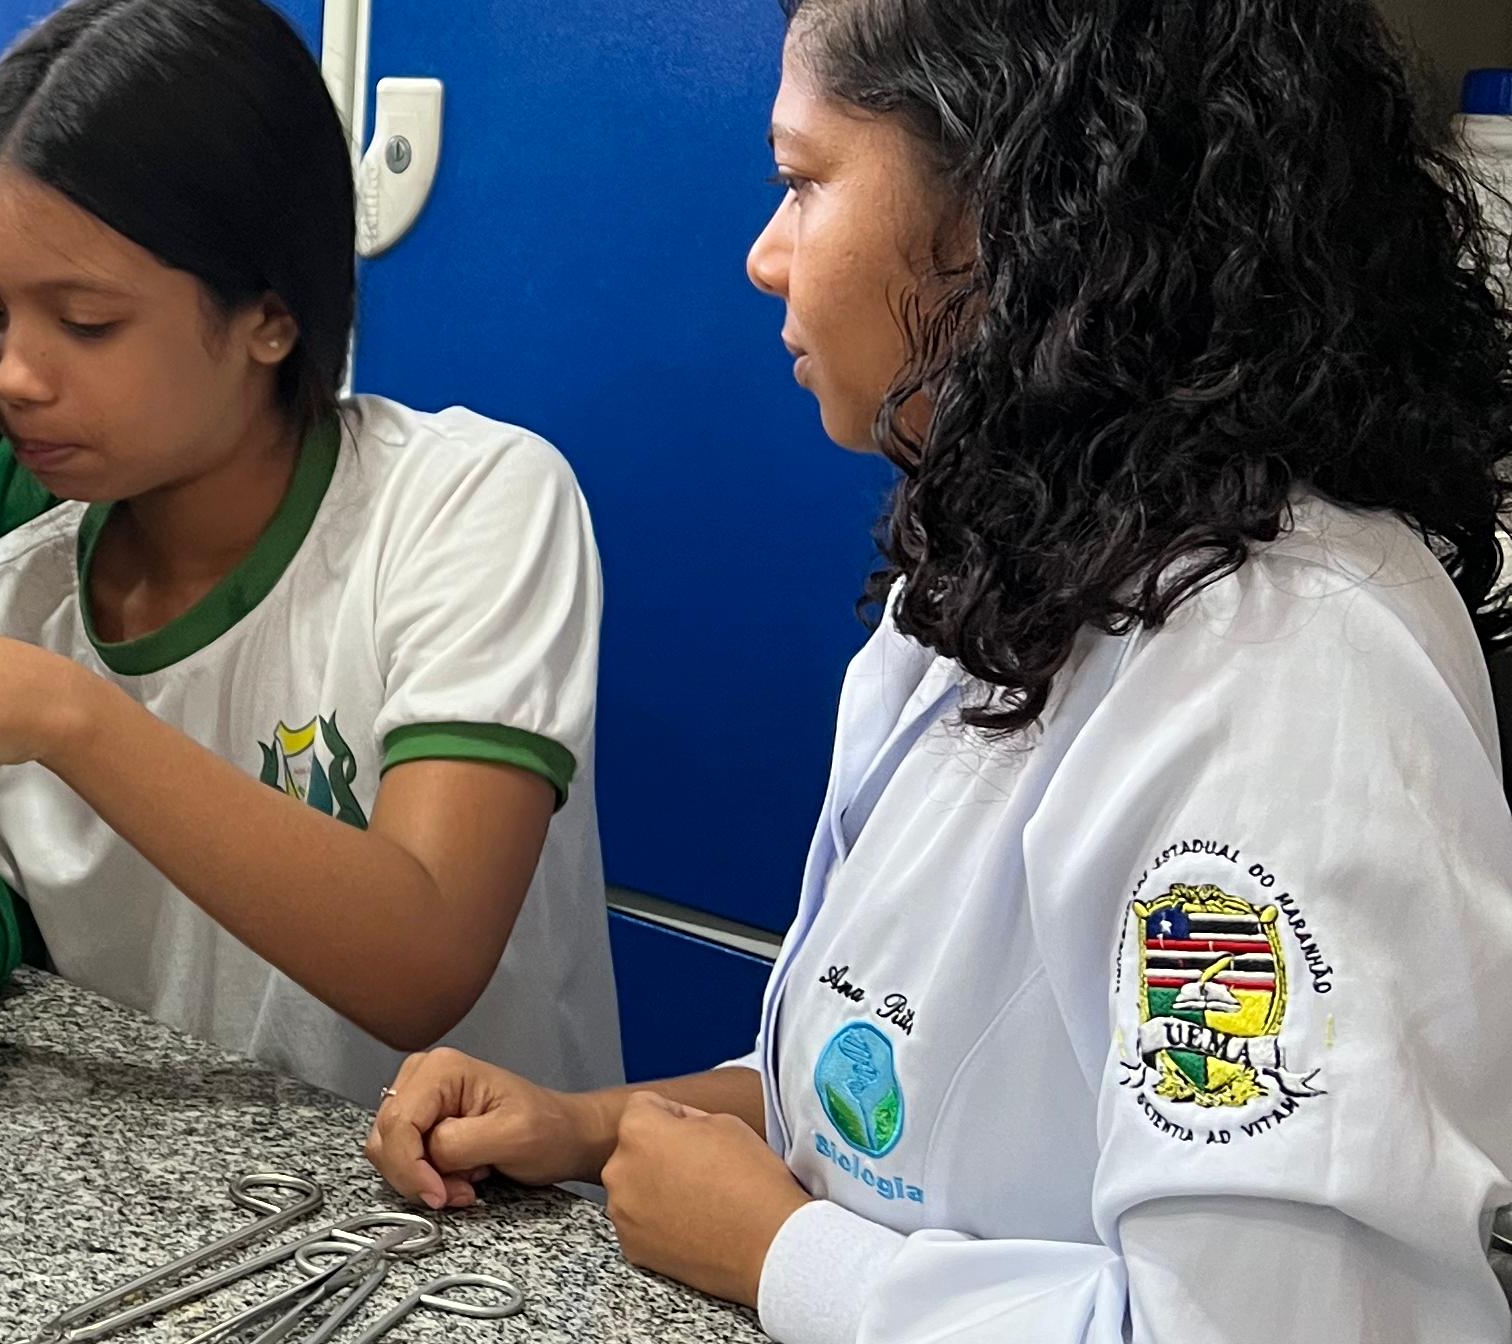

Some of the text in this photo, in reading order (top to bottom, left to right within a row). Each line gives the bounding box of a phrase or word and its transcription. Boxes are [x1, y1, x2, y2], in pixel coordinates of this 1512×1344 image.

[1248, 863, 1275, 887] DO
[1274, 892, 1334, 994] MARANHÃO
[819, 965, 865, 1003] Ana
[1162, 1021, 1252, 1070] UEMA
[1206, 1129, 1231, 1145] AD
[815, 1132, 925, 1204] Biologia
